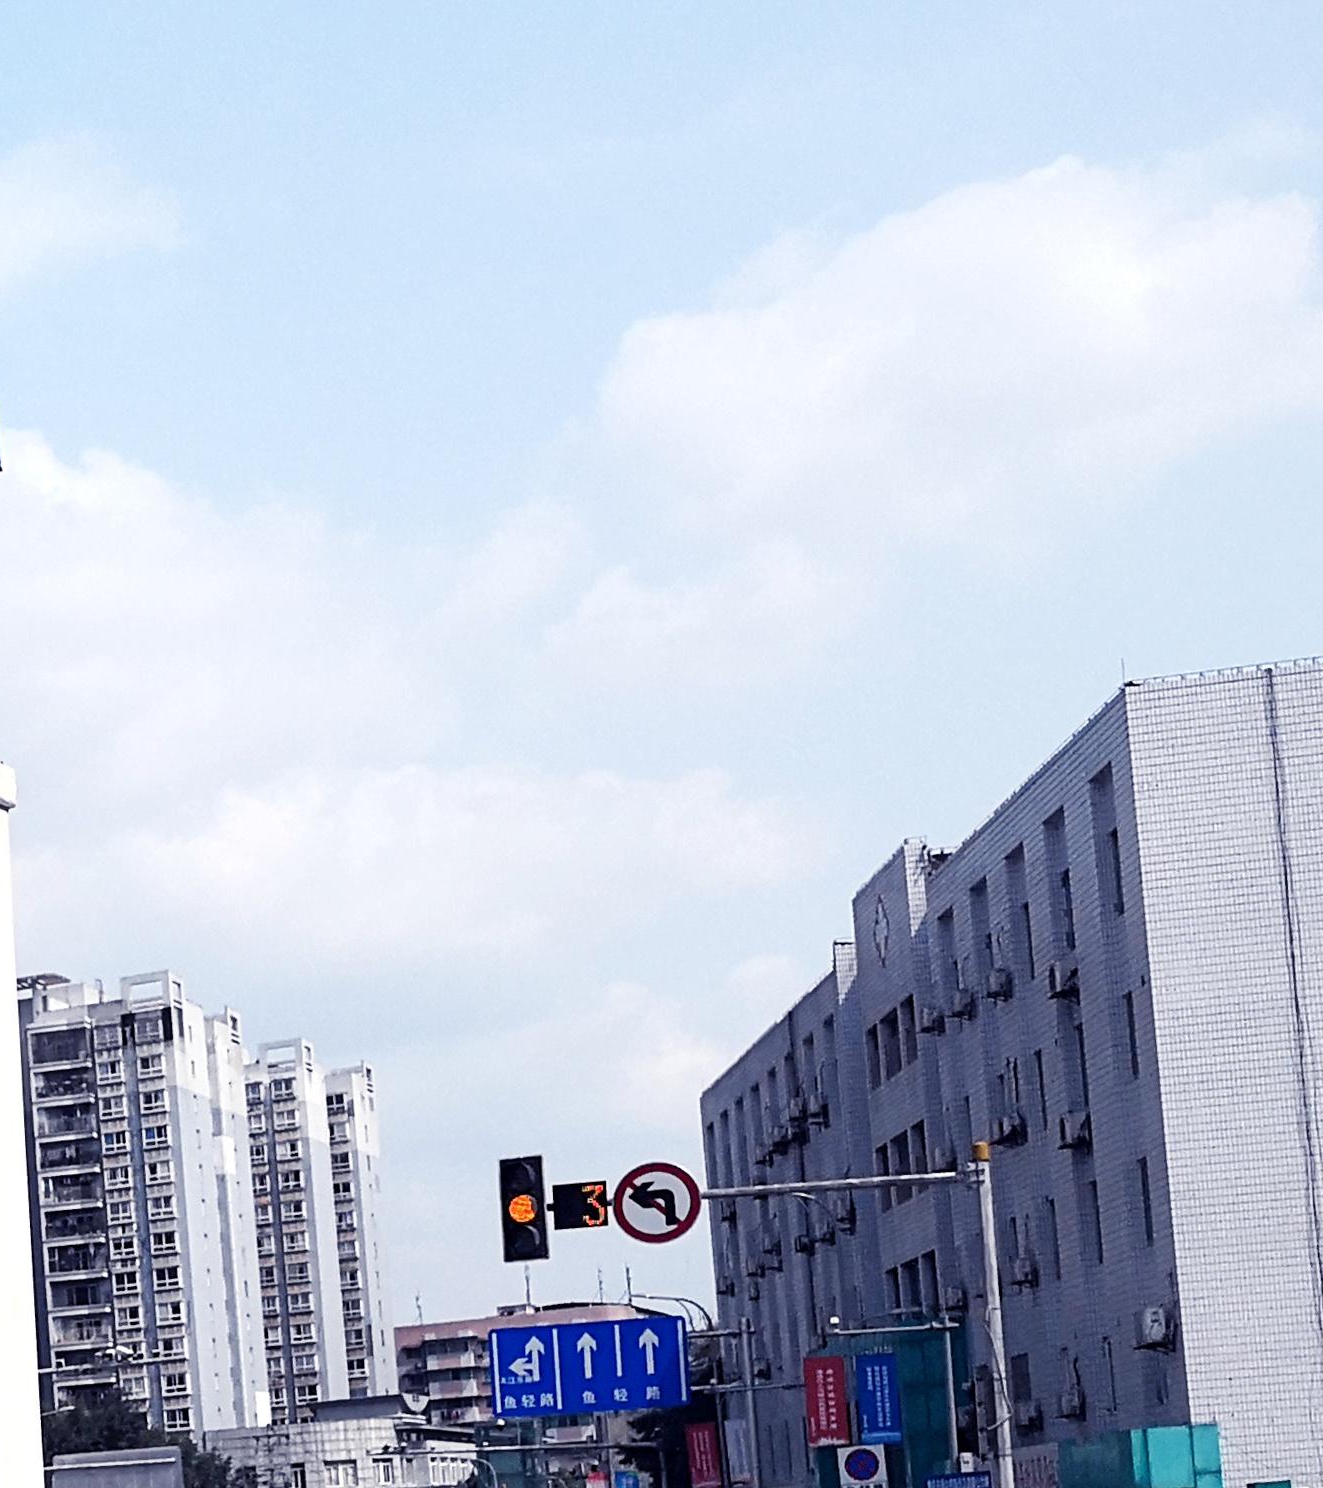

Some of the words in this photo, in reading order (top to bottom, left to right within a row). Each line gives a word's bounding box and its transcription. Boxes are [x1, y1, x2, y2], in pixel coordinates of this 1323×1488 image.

[582, 1184, 606, 1226] 3
[504, 1393, 554, 1410] 鱼轻路
